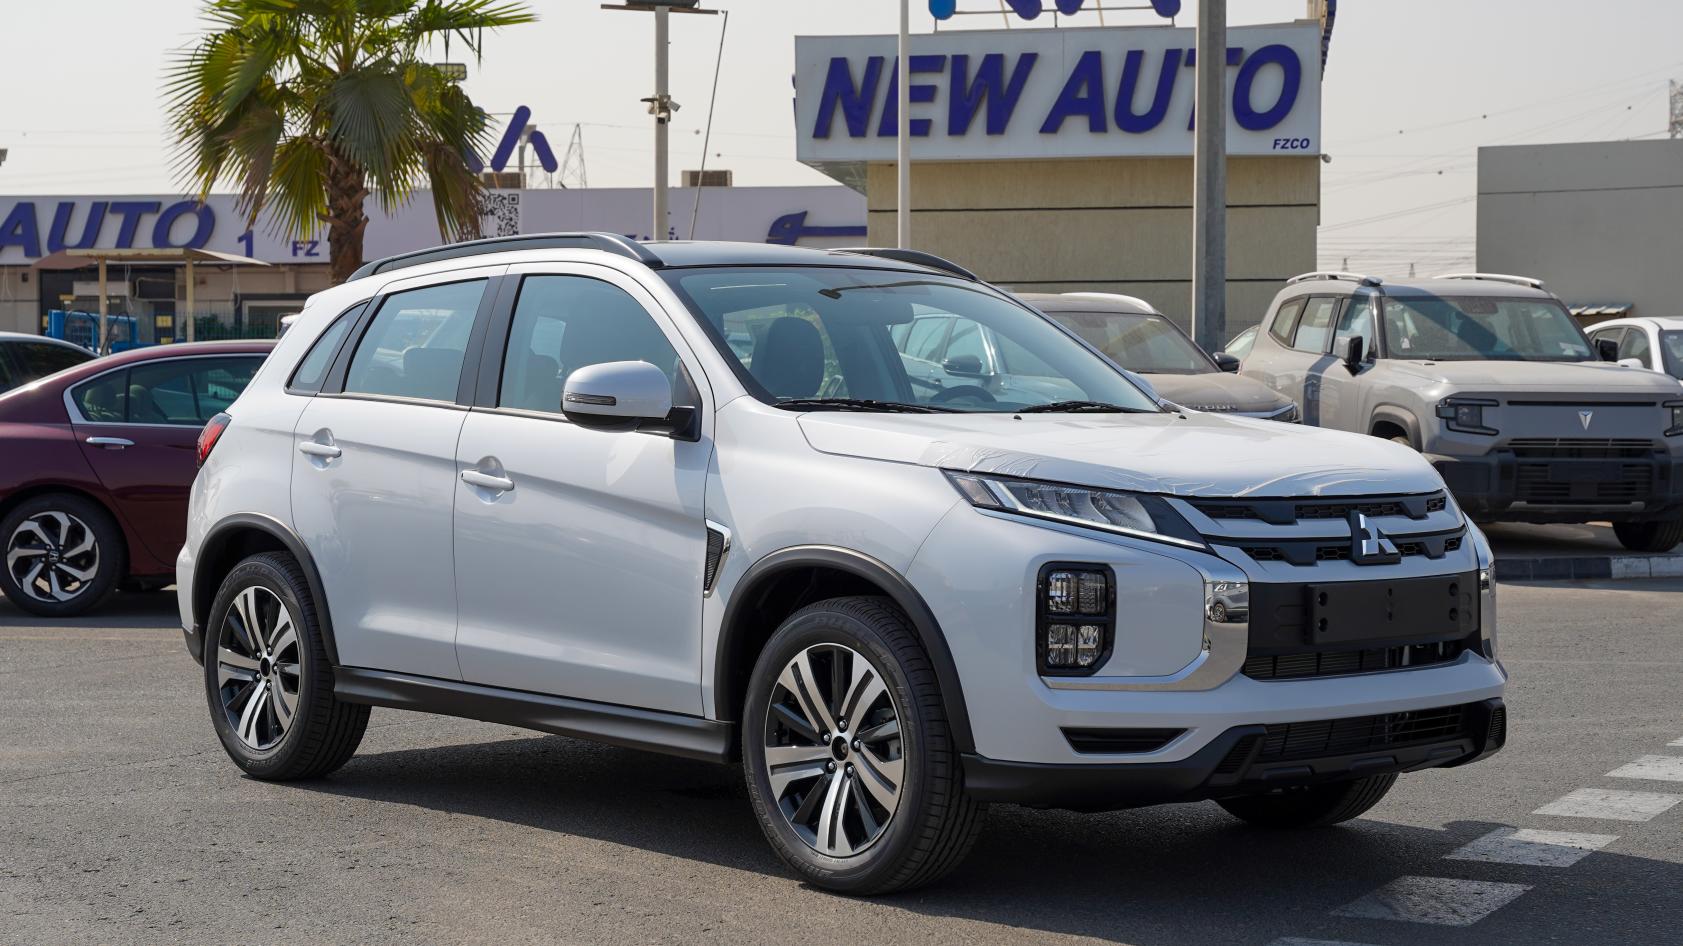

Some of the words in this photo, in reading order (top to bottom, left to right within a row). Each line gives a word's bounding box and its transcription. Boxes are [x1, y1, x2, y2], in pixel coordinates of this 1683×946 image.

[812, 53, 1038, 139] NEW
[1273, 138, 1310, 150] FZCO
[0, 201, 216, 258] AUTO
[237, 229, 254, 259] 1
